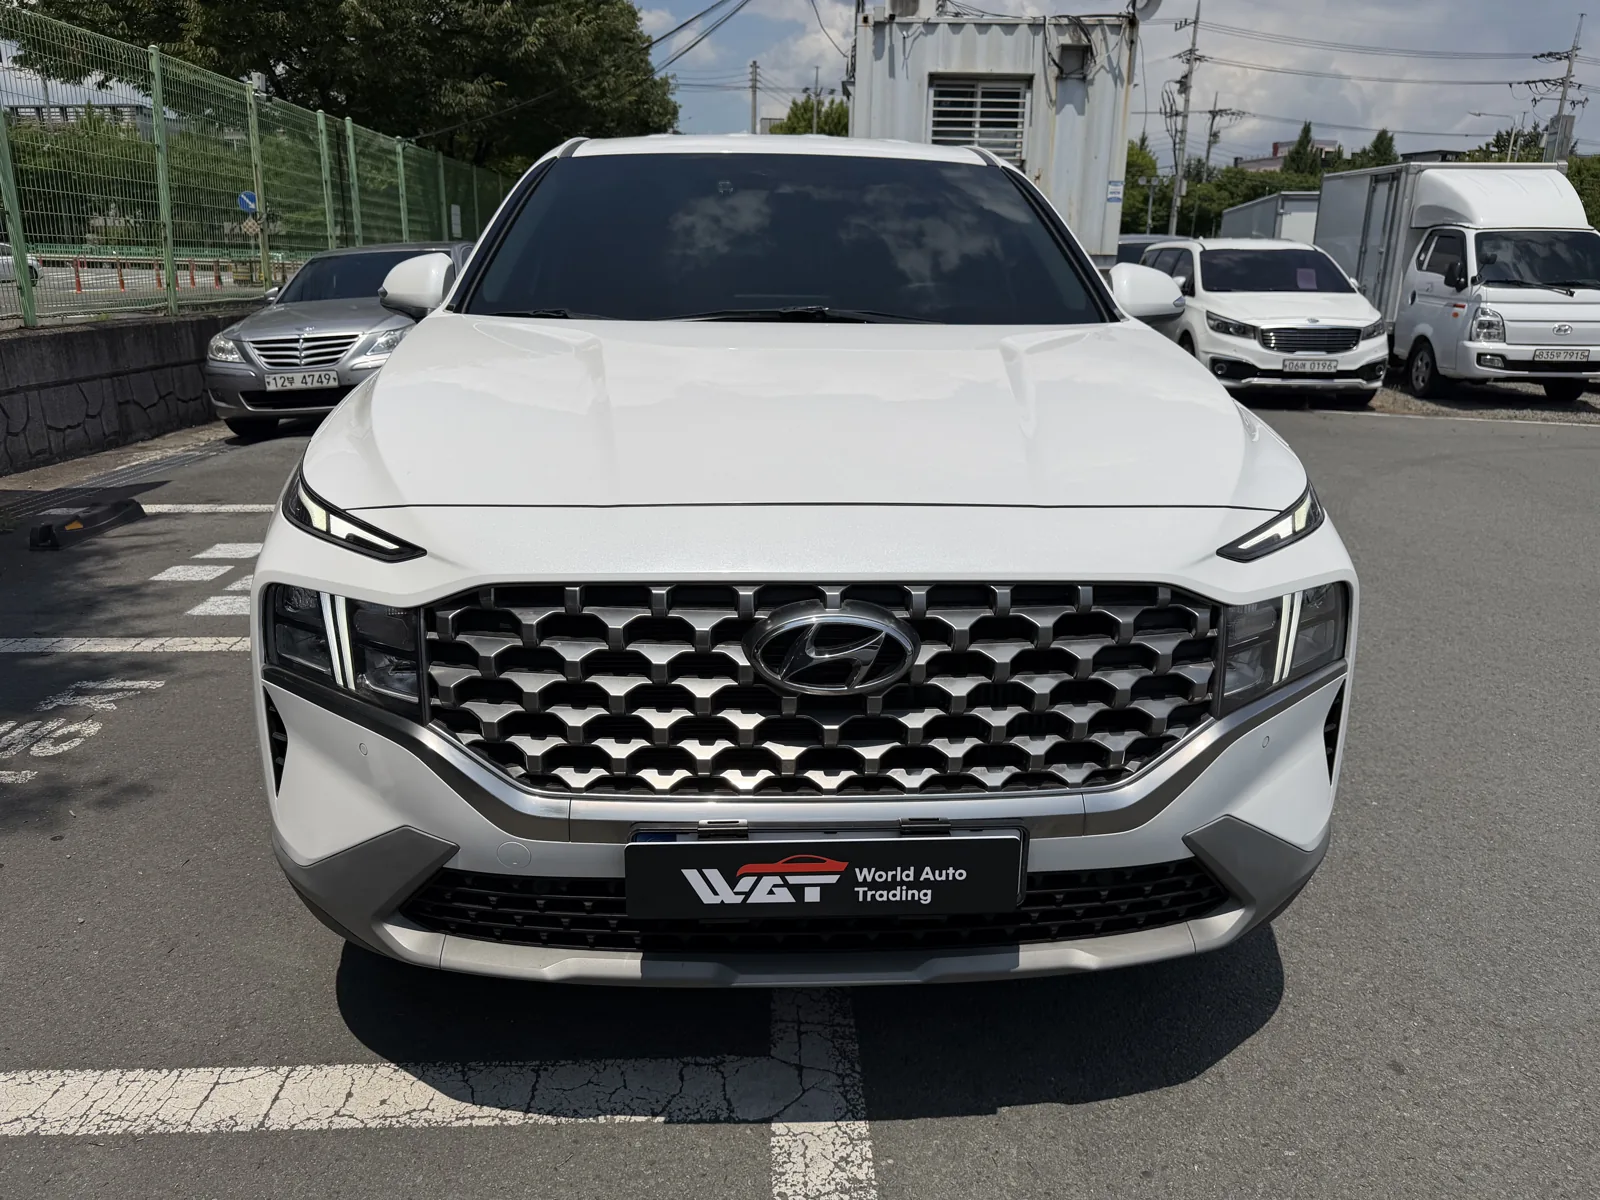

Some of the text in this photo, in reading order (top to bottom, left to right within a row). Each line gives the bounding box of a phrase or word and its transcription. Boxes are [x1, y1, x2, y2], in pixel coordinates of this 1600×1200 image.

[1563, 351, 1586, 360] 7915
[272, 373, 332, 388] 12부 4749
[854, 866, 967, 882] World Auto
[854, 885, 932, 905] Trading
